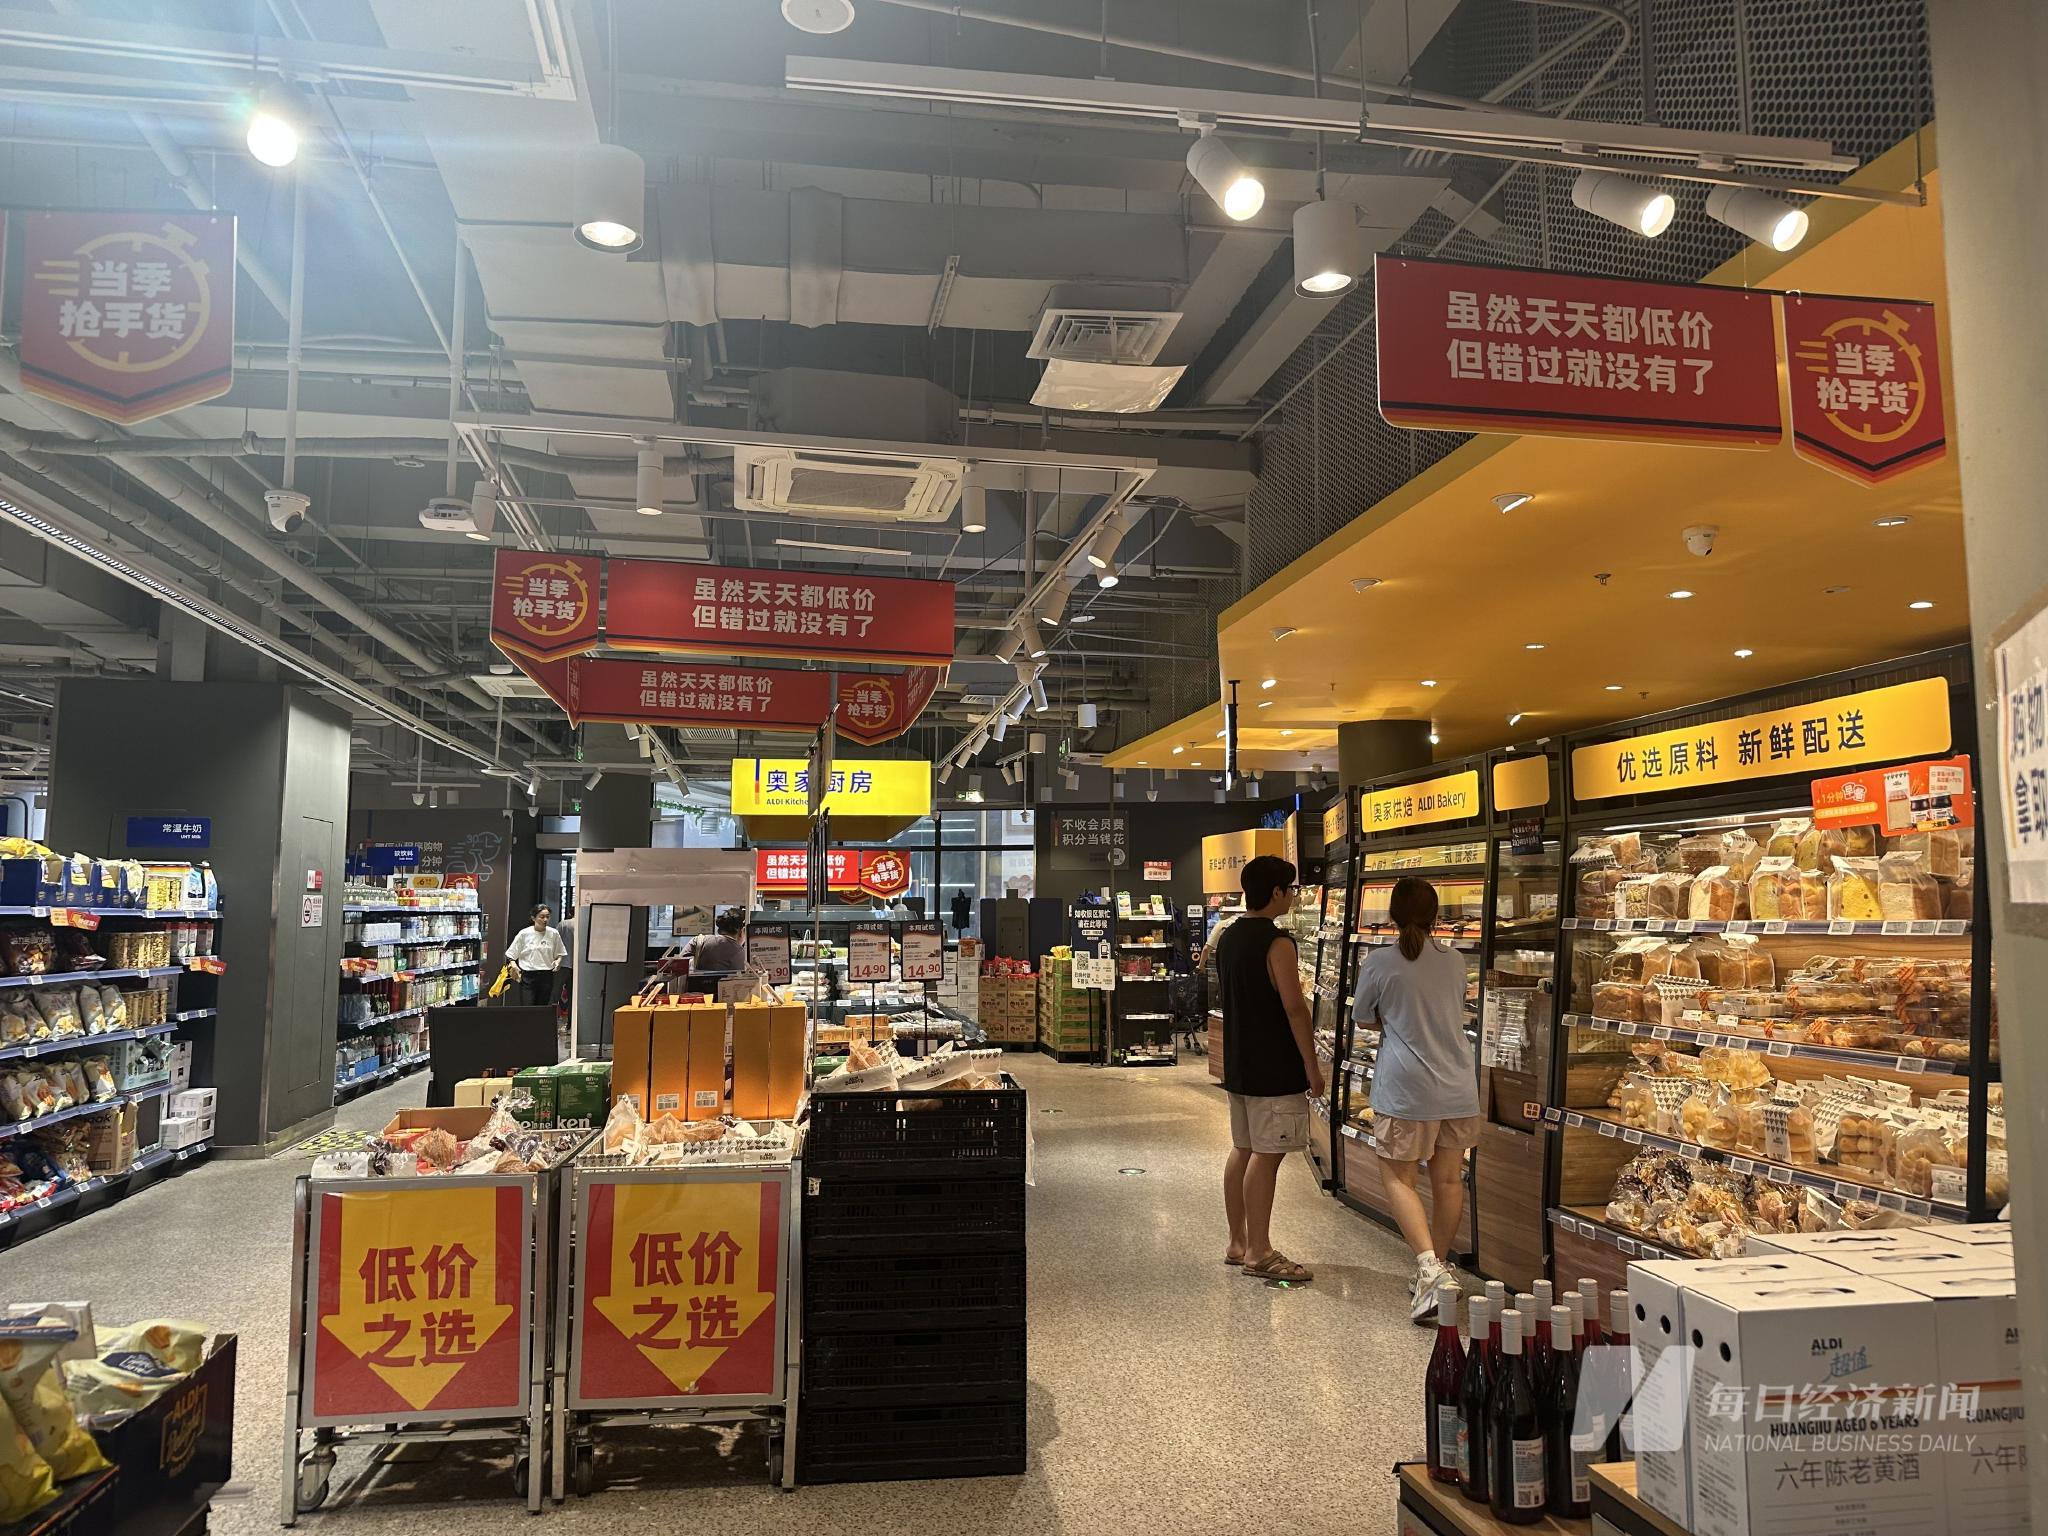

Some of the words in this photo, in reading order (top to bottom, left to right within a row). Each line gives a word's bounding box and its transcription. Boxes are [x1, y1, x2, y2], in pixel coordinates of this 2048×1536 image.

[89, 260, 172, 298] 当季
[59, 300, 186, 340] 抢手货
[1446, 290, 1713, 351] 虽然天天都低价
[1446, 338, 1714, 395] 但错过就没有了
[1834, 342, 1896, 376] 当季
[1817, 377, 1910, 415] 抢手货
[528, 577, 569, 598] 当季
[694, 577, 875, 611] 虽然天天都低价
[513, 598, 576, 621] 抢手货
[692, 605, 874, 638] 但错过就没有了
[640, 670, 773, 694] 虽然天天都低价
[639, 690, 772, 713] 但错过就没有了
[856, 690, 883, 703] 当季
[847, 703, 887, 719] 抢手货
[1617, 736, 1718, 783] 优选原料
[1738, 708, 1866, 765] 新鲜配送
[1373, 800, 1413, 822] 奥家烘焙
[1417, 797, 1435, 812] ALDI
[1437, 791, 1466, 809] Bakery
[162, 823, 202, 833] 常温牛奶
[1062, 819, 1124, 831] 不收会员费
[1062, 833, 1125, 845] 积分当钱花
[766, 855, 845, 867] 虽然天天低价
[766, 868, 845, 879] 但错过就有了
[854, 965, 886, 978] 14.90
[908, 964, 940, 978] 14.90
[629, 1231, 743, 1288] 低价
[358, 1242, 478, 1305] 低价
[629, 1294, 739, 1350] 之选
[361, 1308, 478, 1367] 之选
[1811, 1338, 1842, 1350] ALDI
[1835, 1417, 1867, 1433] AGED
[1774, 1453, 1920, 1491] 六年陈老黄酒
